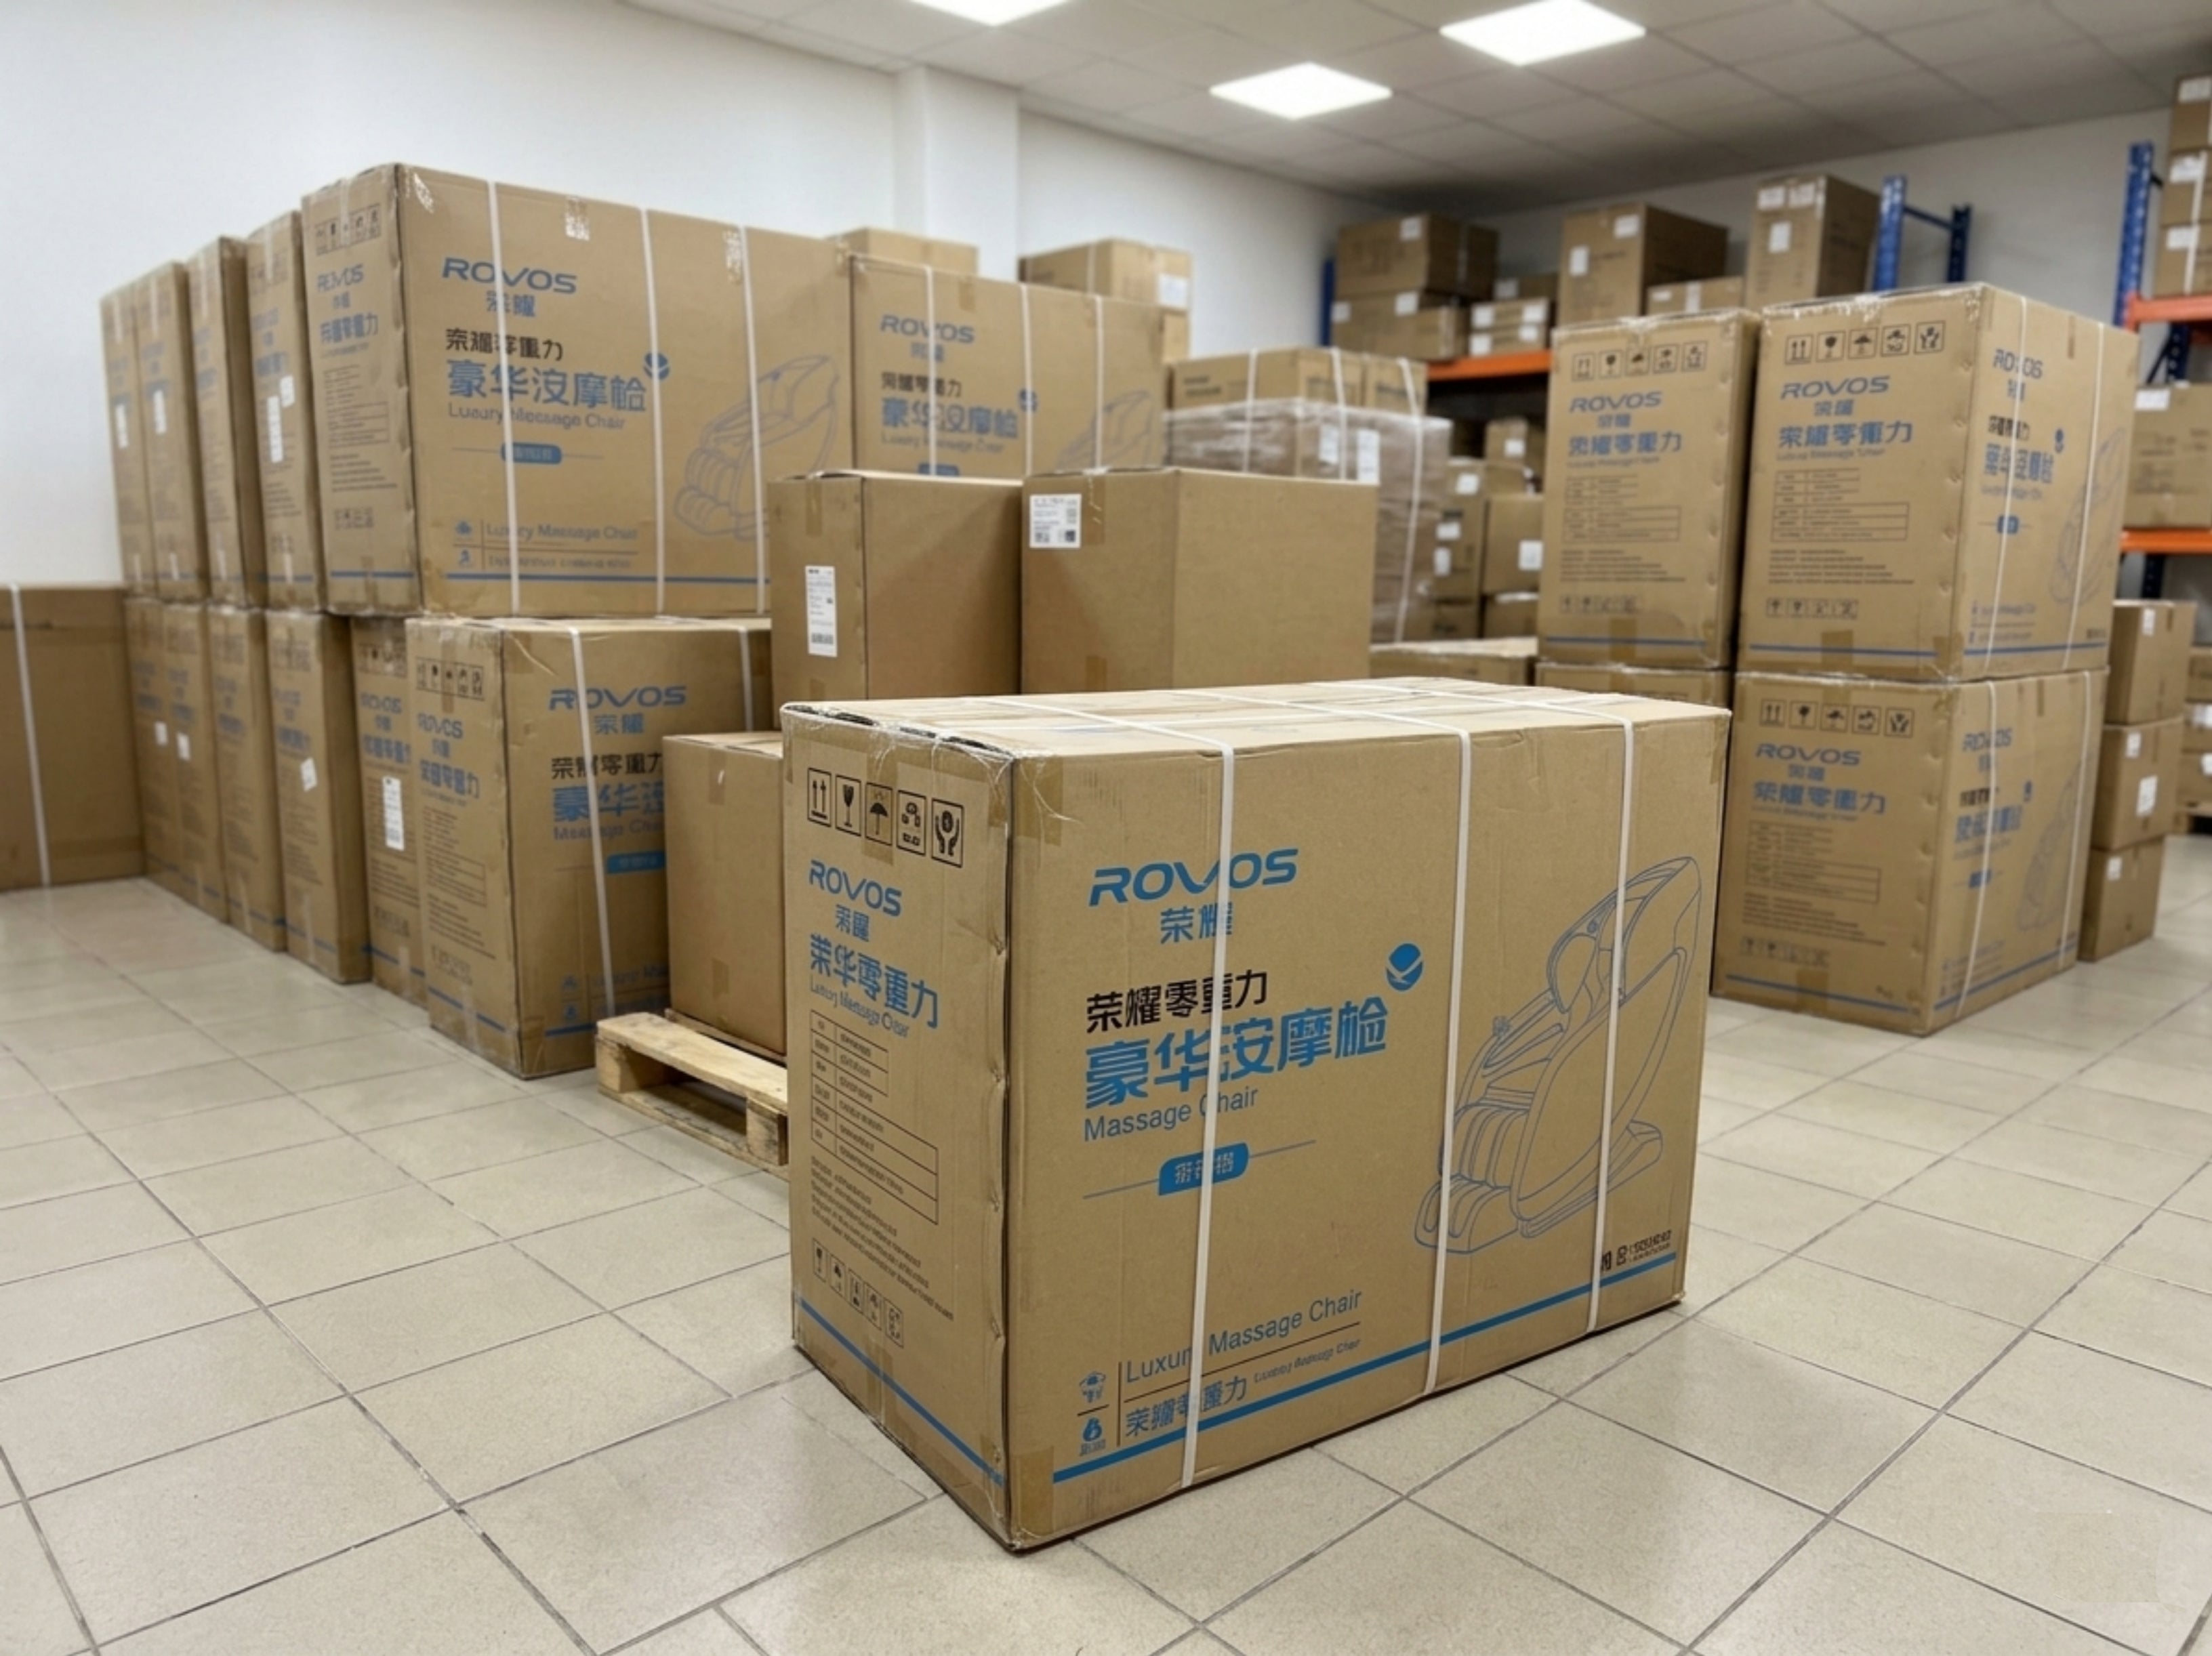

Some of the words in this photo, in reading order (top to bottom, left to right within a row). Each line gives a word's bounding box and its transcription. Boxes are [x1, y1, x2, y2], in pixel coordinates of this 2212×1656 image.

[442, 257, 577, 294] ROVOS
[880, 314, 975, 344] ROVOS
[1570, 391, 1662, 413] ROVOS
[1781, 375, 1890, 400] ROVOS
[549, 685, 687, 711] ROVOS
[1756, 743, 1862, 766] ROVOS
[808, 859, 903, 917] ROVOS
[1088, 848, 1299, 907] ROVOS
[1084, 1104, 1191, 1142] Massage
[1126, 1344, 1194, 1384] Luxur
[1208, 1308, 1303, 1356] Massage
[1309, 1289, 1363, 1323] Chair
